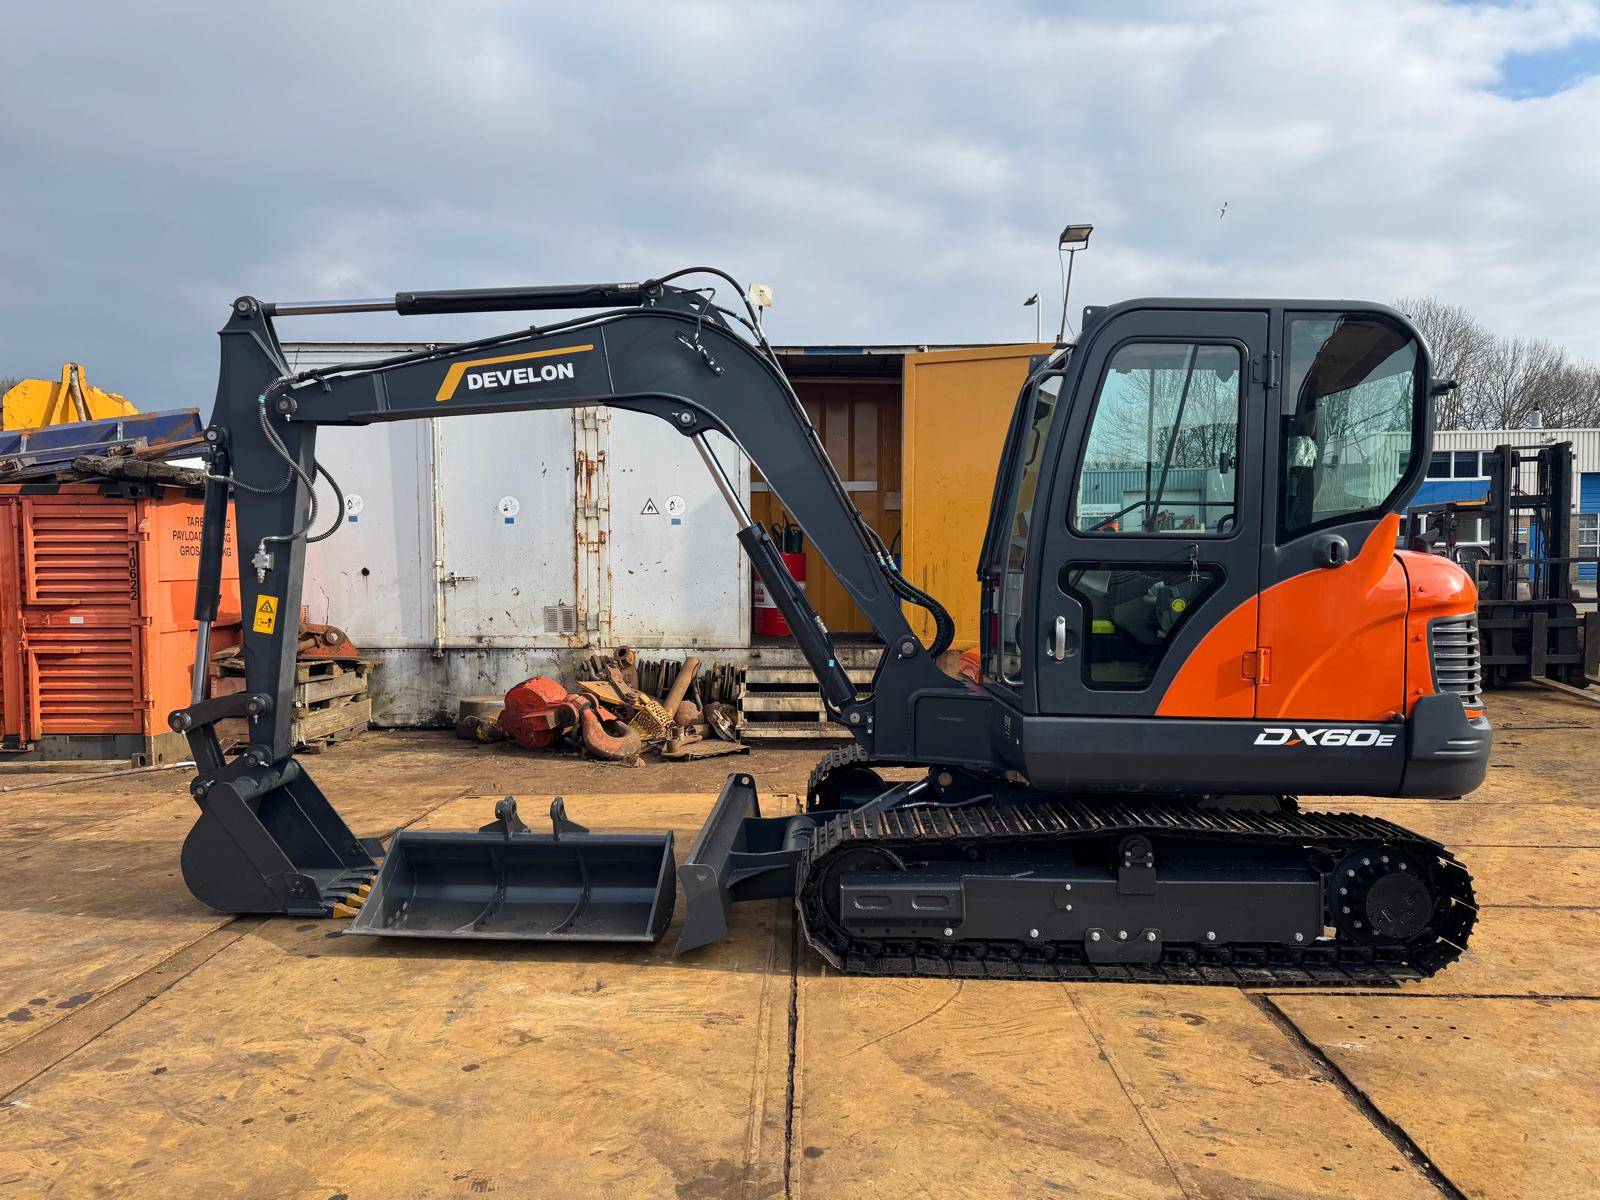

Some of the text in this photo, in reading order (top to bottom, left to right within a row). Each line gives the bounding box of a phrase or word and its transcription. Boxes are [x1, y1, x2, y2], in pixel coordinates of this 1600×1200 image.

[466, 362, 575, 390] DEVELON
[180, 545, 201, 556] GROS
[129, 546, 137, 600] 10622
[1253, 728, 1396, 747] DX60E
